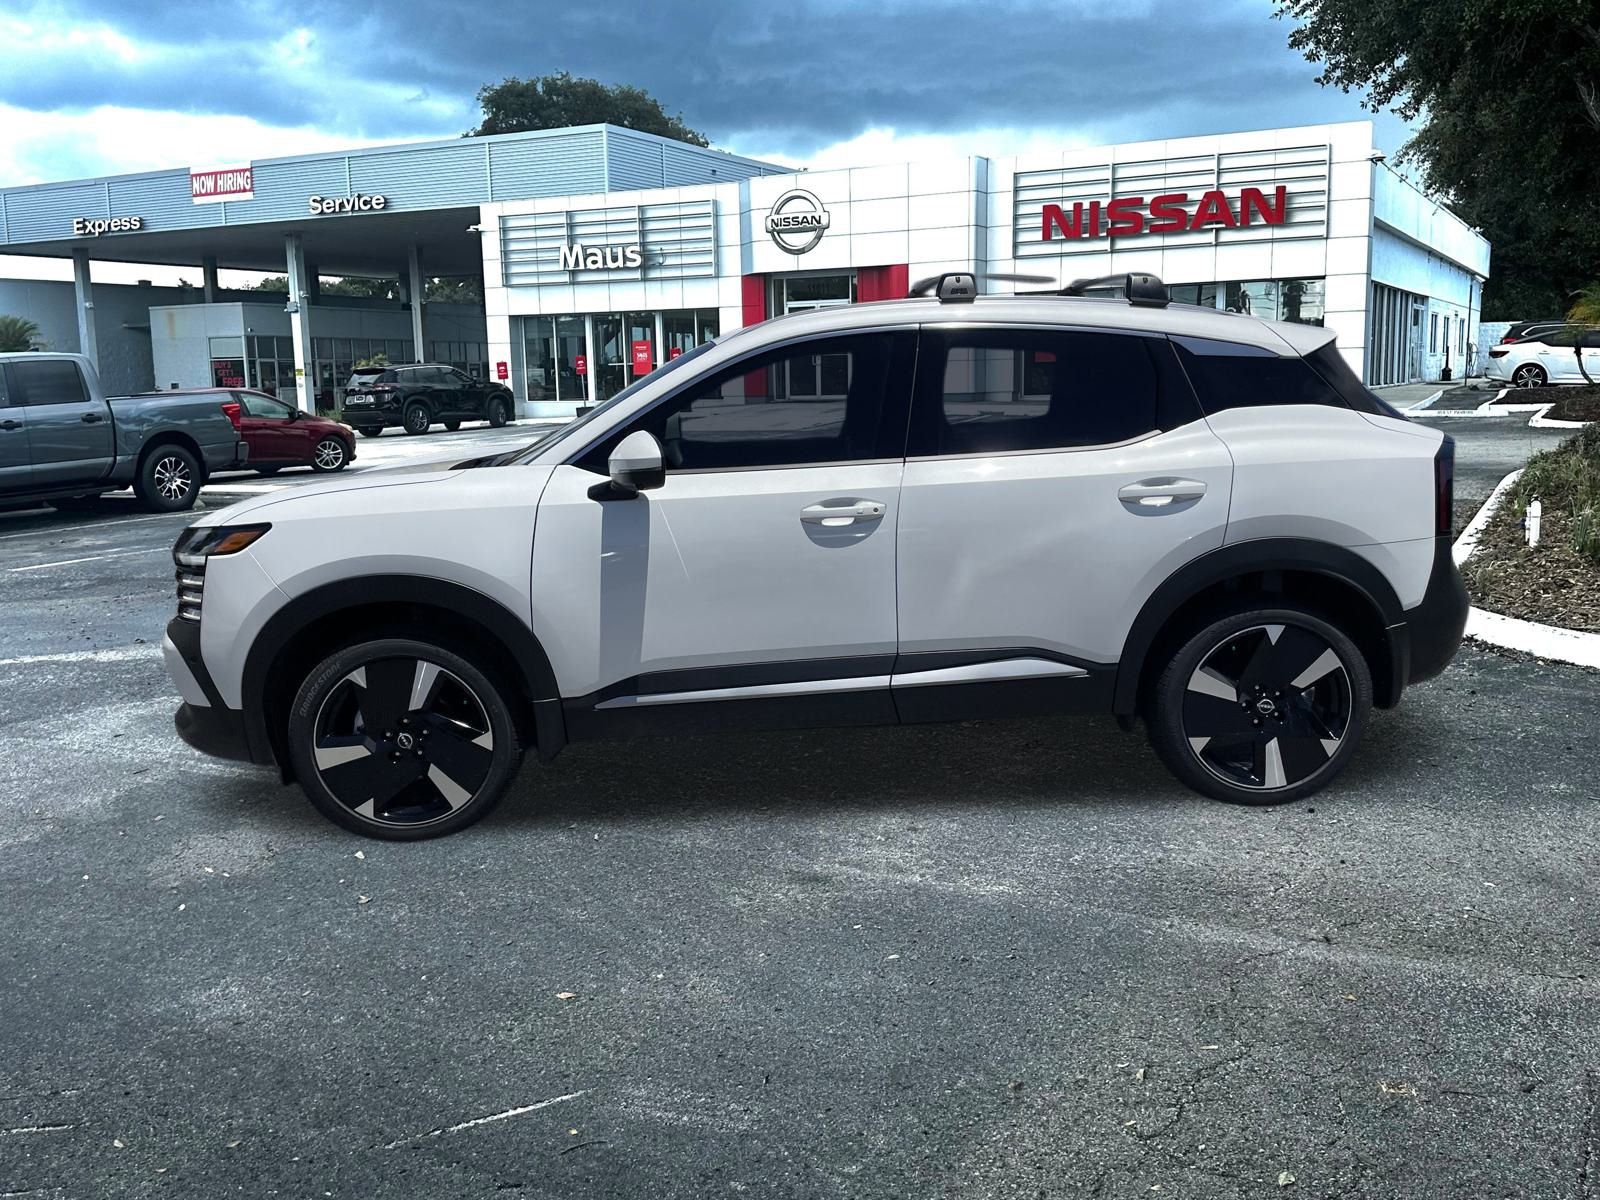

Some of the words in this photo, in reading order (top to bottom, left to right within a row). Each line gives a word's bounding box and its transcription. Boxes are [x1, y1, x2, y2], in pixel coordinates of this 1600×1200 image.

[192, 174, 217, 195] NOW
[216, 171, 251, 192] HIRING
[309, 193, 385, 215] Service
[1042, 185, 1287, 241] NISSAN
[72, 216, 141, 236] Express
[770, 215, 822, 229] NISSAN
[559, 243, 642, 270] Maus
[222, 377, 244, 387] FREE
